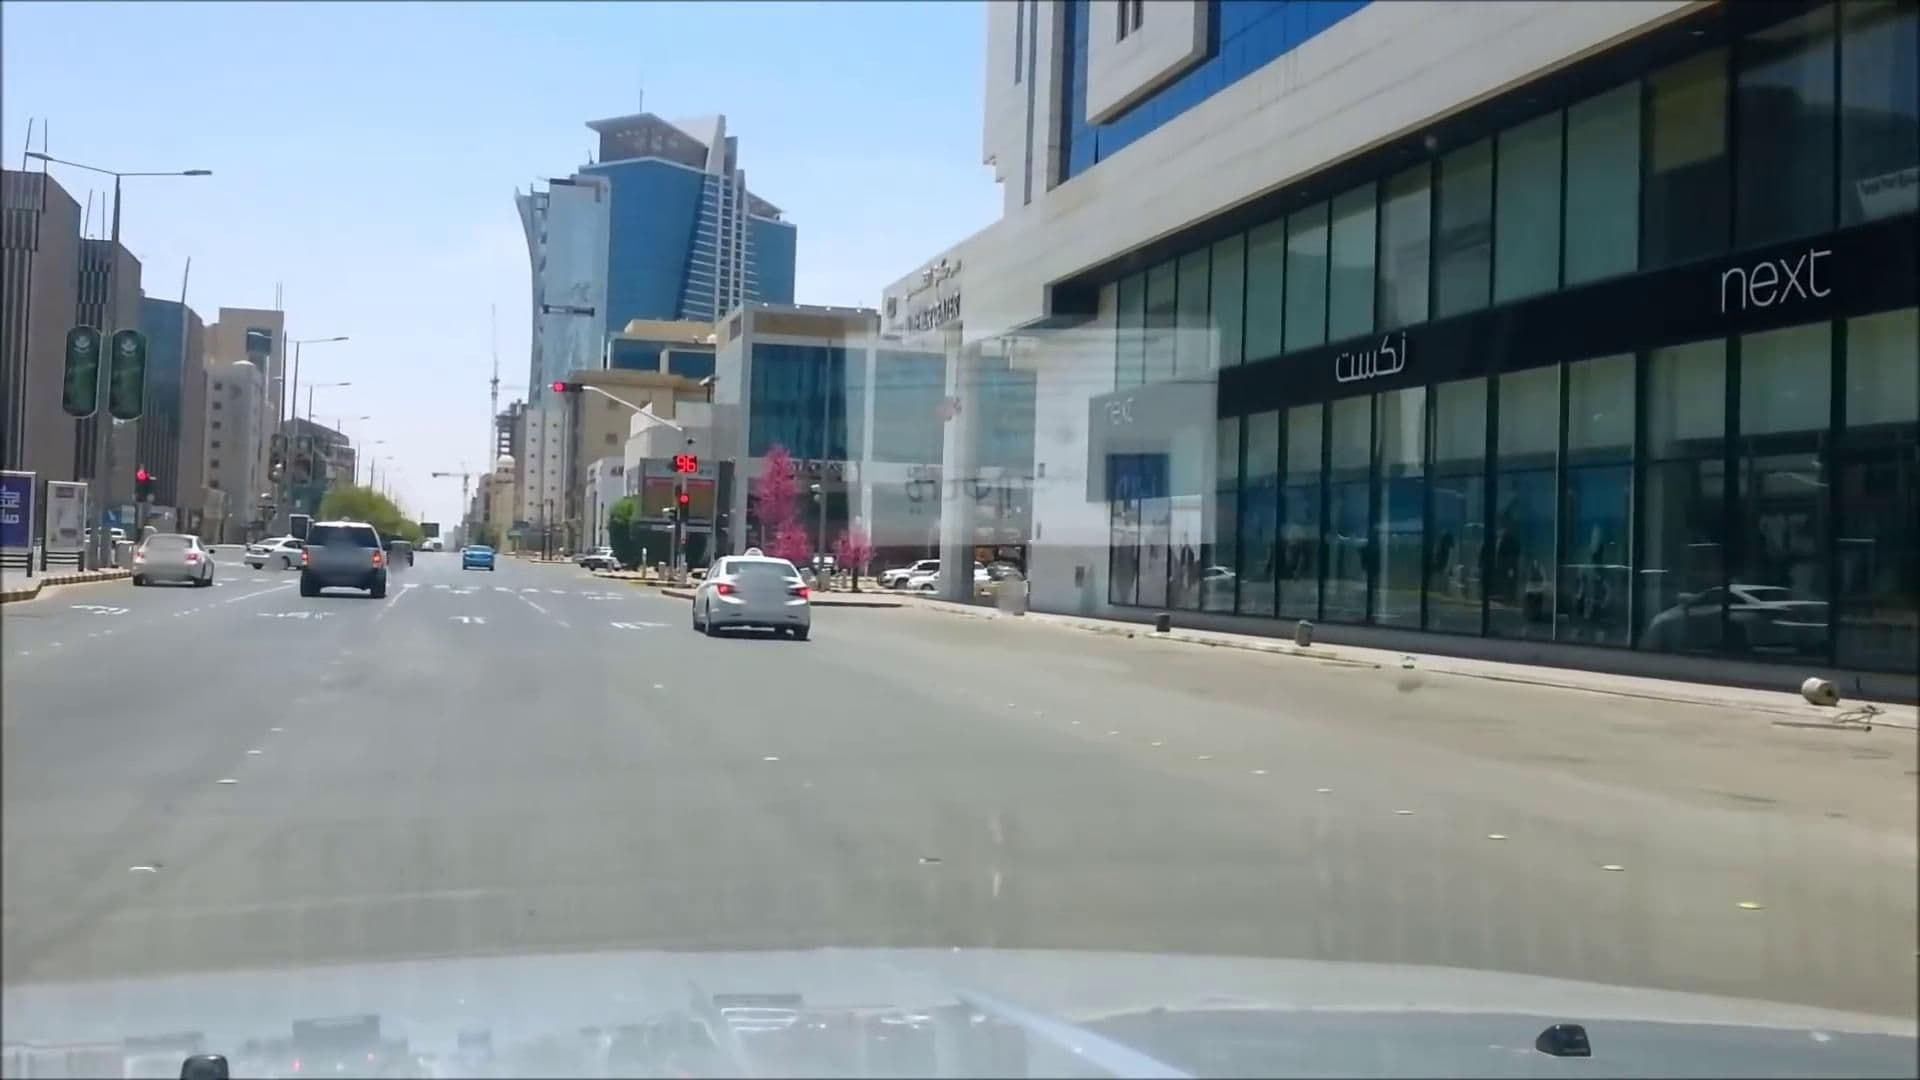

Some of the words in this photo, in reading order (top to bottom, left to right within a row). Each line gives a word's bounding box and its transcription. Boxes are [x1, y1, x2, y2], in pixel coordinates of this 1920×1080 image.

[1721, 248, 1832, 313] next
[1335, 331, 1407, 383] نكست
[676, 455, 696, 473] 96
